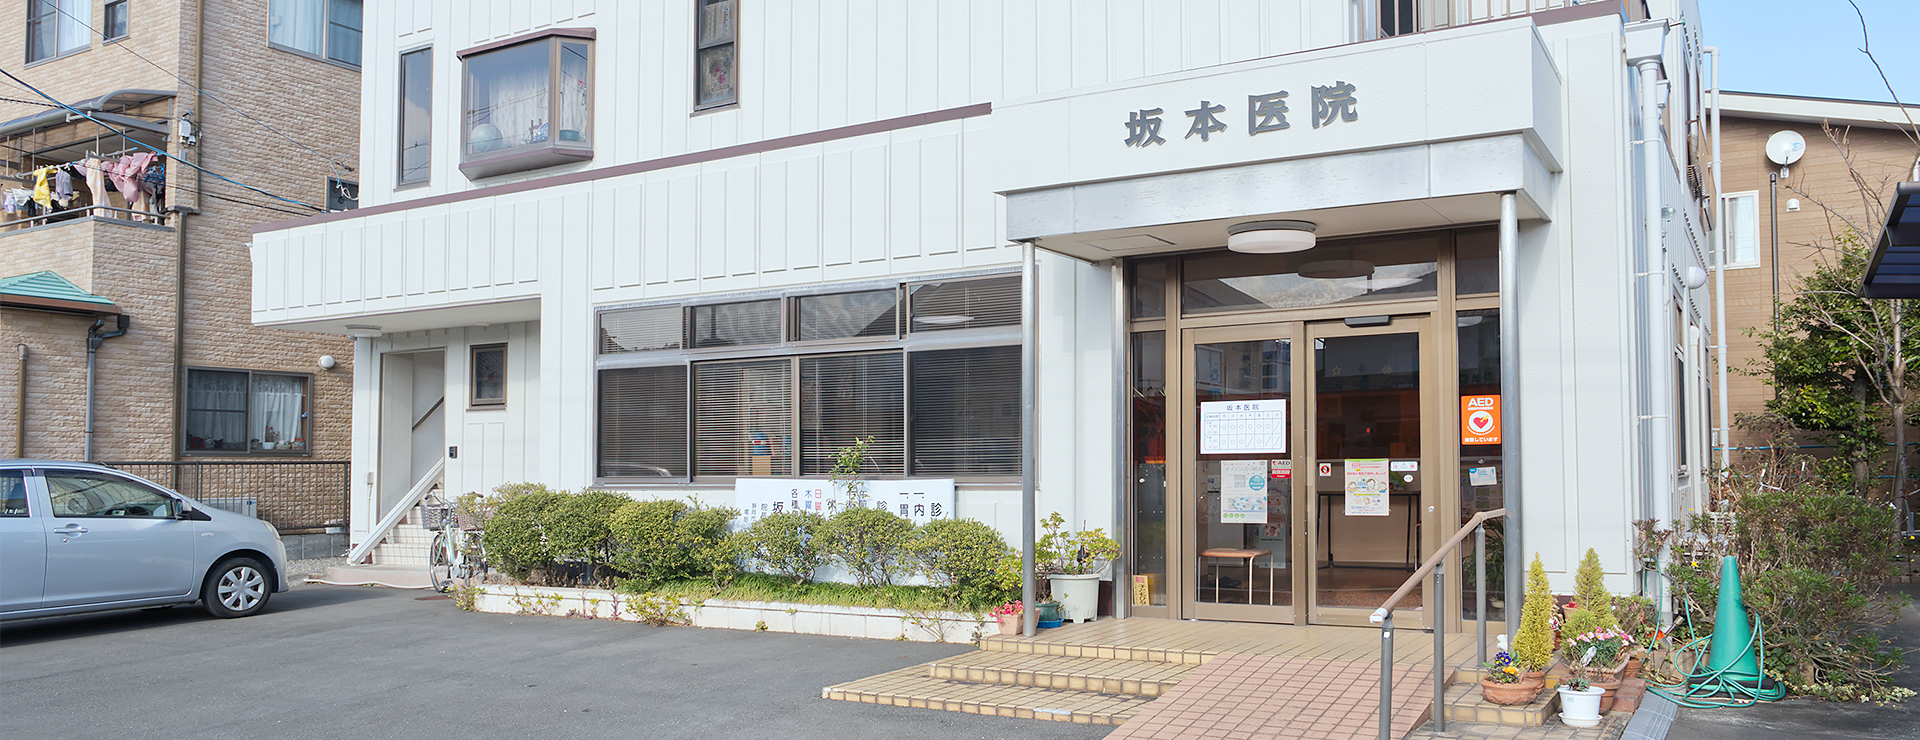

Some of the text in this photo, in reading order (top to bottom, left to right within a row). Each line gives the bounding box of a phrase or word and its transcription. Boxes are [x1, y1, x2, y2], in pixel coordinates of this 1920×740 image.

[1124, 80, 1359, 148] 坂本医院
[1468, 397, 1494, 407] AED
[931, 503, 942, 517] 診
